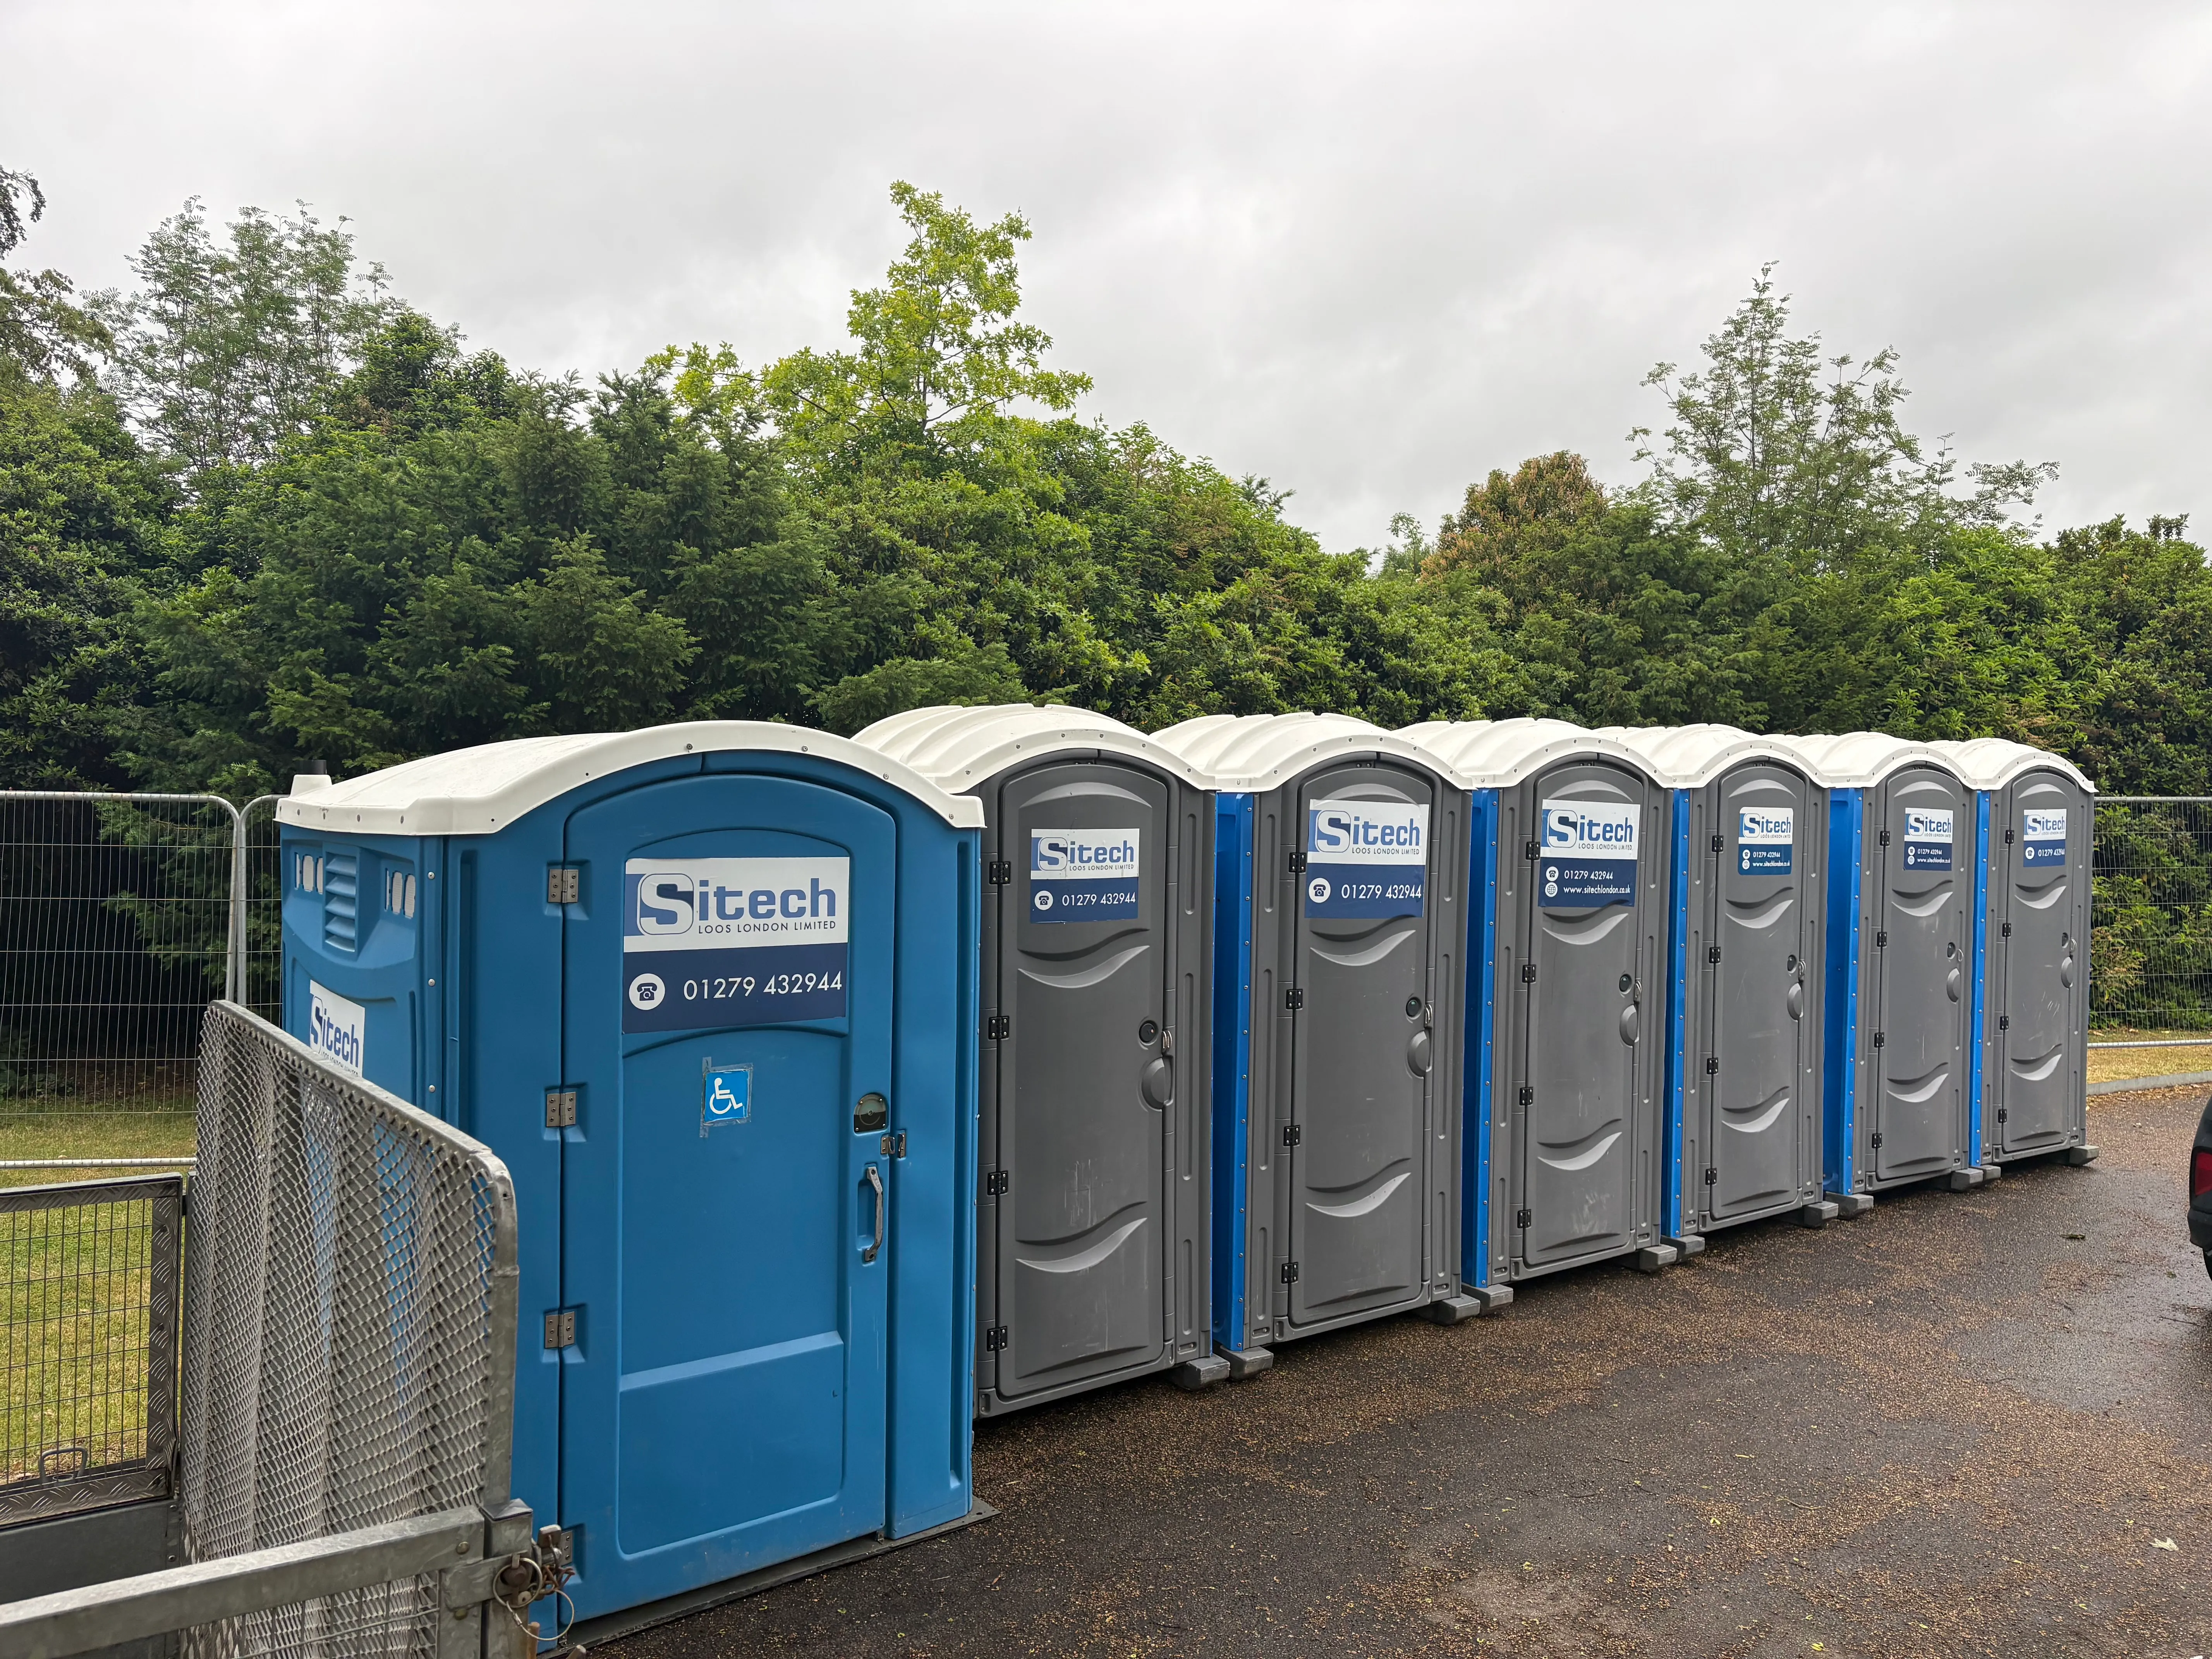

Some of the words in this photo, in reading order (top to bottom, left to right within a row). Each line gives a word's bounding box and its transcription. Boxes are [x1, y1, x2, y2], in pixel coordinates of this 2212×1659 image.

[1317, 810, 1420, 852] Sitech
[1549, 810, 1633, 848] Sitech
[1744, 813, 1791, 838] Sitech
[1910, 814, 1951, 836] Sitech
[2028, 815, 2064, 835] Sitech
[1039, 837, 1134, 871] Sitech
[1564, 871, 1588, 879] 01279
[1590, 871, 1613, 879] 432944
[1062, 894, 1097, 906] 01279
[1100, 892, 1135, 905] 432944
[1341, 884, 1382, 899] 01279
[1385, 884, 1421, 899] 432944
[1563, 884, 1630, 893] www.sitechlondon.co.uk
[640, 873, 836, 934] Sitech
[698, 924, 731, 934] LOOS
[738, 922, 788, 933] LONDON
[795, 921, 836, 931] LIMITED
[684, 977, 754, 1000] 01279
[763, 971, 842, 995] 432944
[311, 996, 359, 1068] Sitech
